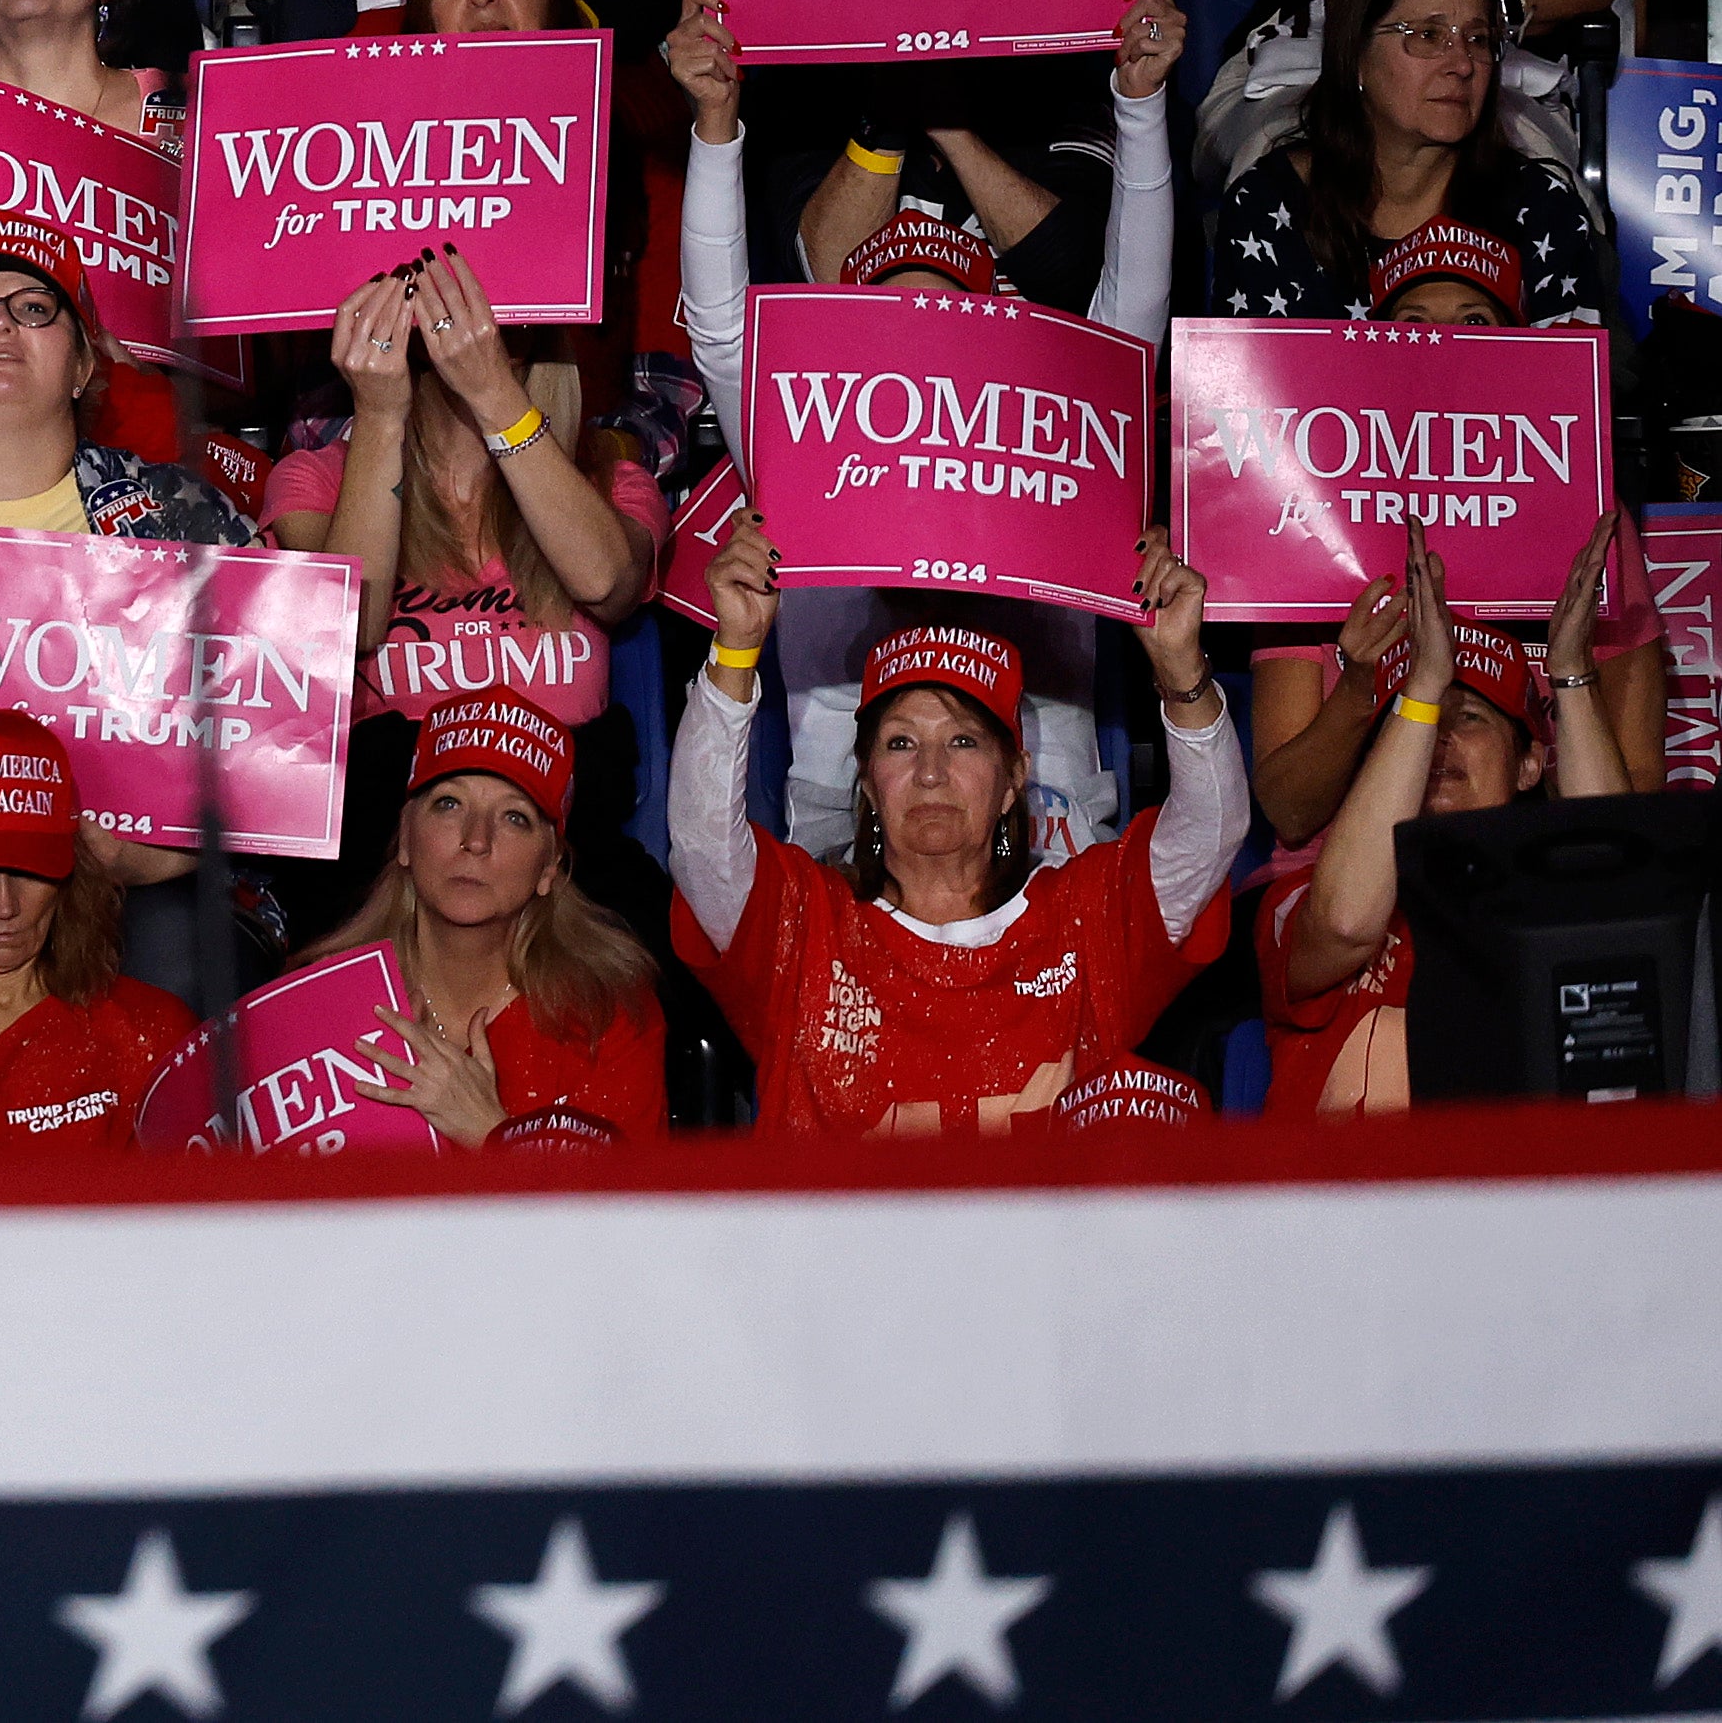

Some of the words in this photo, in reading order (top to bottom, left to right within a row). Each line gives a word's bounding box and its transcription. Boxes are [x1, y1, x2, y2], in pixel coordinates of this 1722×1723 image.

[897, 31, 969, 52] 2024
[215, 116, 577, 198] WOMEN
[264, 204, 323, 249] for
[333, 197, 510, 231] TRUMP
[771, 373, 1131, 483] WOMEN
[1206, 403, 1578, 487] WOMEN
[825, 454, 889, 499] for
[899, 456, 1077, 505] TRUMP
[97, 493, 144, 519] TRUMP
[1269, 493, 1332, 536] for
[1341, 491, 1516, 526] TRUMP
[912, 560, 986, 583] 2024
[454, 621, 492, 636] FOR
[875, 629, 928, 664] MAKE
[929, 624, 1012, 671] AMERICA
[376, 632, 592, 696] TRUMP
[878, 651, 940, 683] GREAT
[941, 651, 999, 692] AGAIN
[67, 703, 256, 755] TRUMP
[82, 810, 152, 834] 2024
[6, 1103, 65, 1127] TRUMP
[28, 1103, 107, 1136] CAPTAIN
